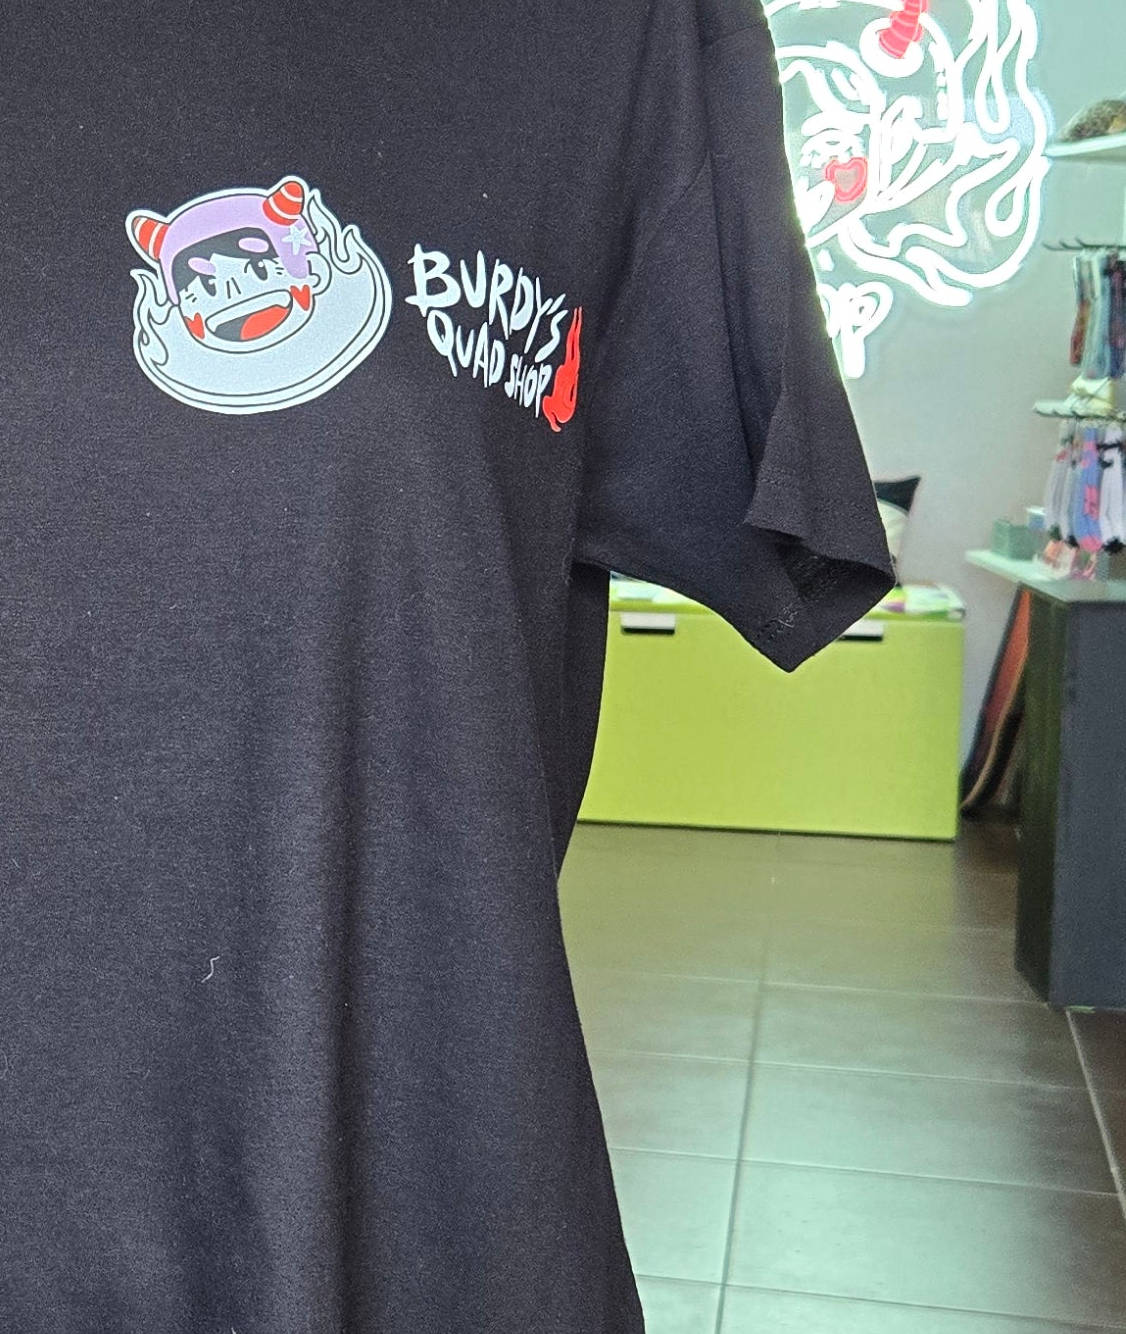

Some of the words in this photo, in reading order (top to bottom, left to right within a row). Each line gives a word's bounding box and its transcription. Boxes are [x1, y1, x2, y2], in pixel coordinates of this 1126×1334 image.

[405, 244, 568, 363] BURDY'S
[426, 310, 506, 388] QUAD
[504, 353, 552, 418] SHOP
